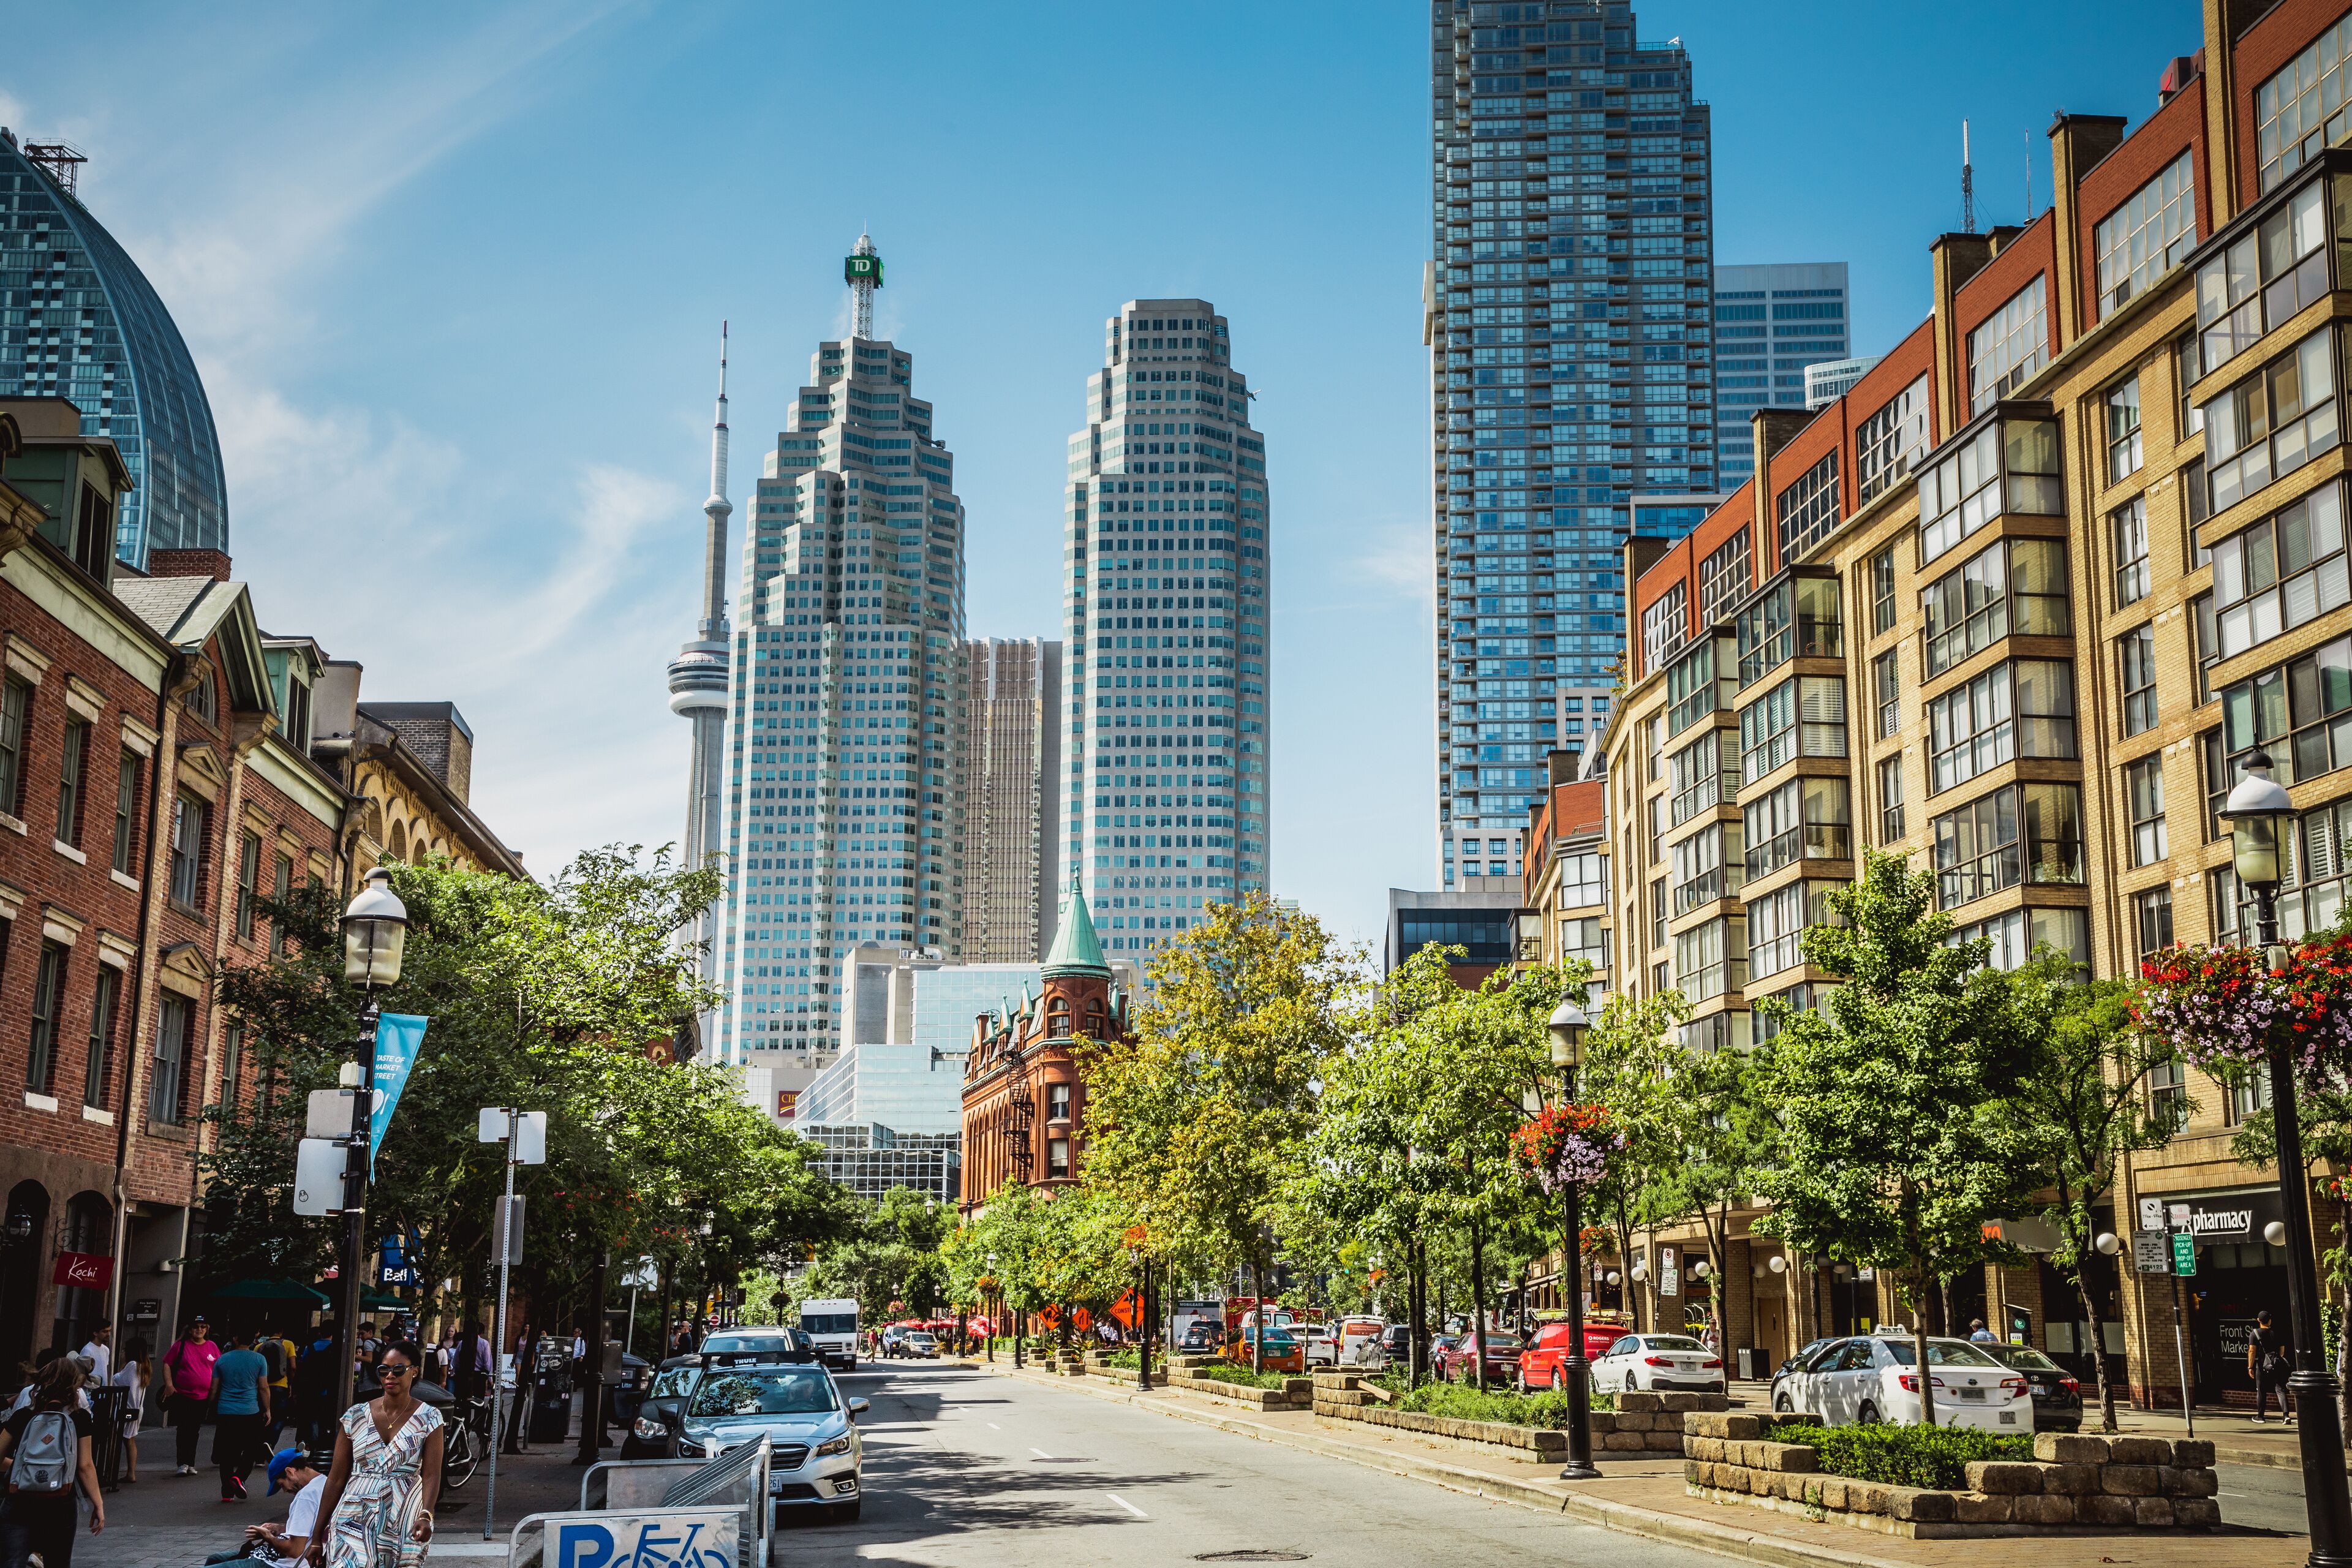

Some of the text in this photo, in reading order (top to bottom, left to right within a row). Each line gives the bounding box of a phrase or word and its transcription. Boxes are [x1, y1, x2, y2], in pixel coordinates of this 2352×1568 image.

[852, 260, 870, 271] TD
[2193, 1208, 2252, 1236] pharmacy
[68, 1257, 98, 1281] Kochi
[384, 1268, 407, 1281] Bell
[2220, 1325, 2243, 1338] Front
[2221, 1340, 2248, 1353] Marke
